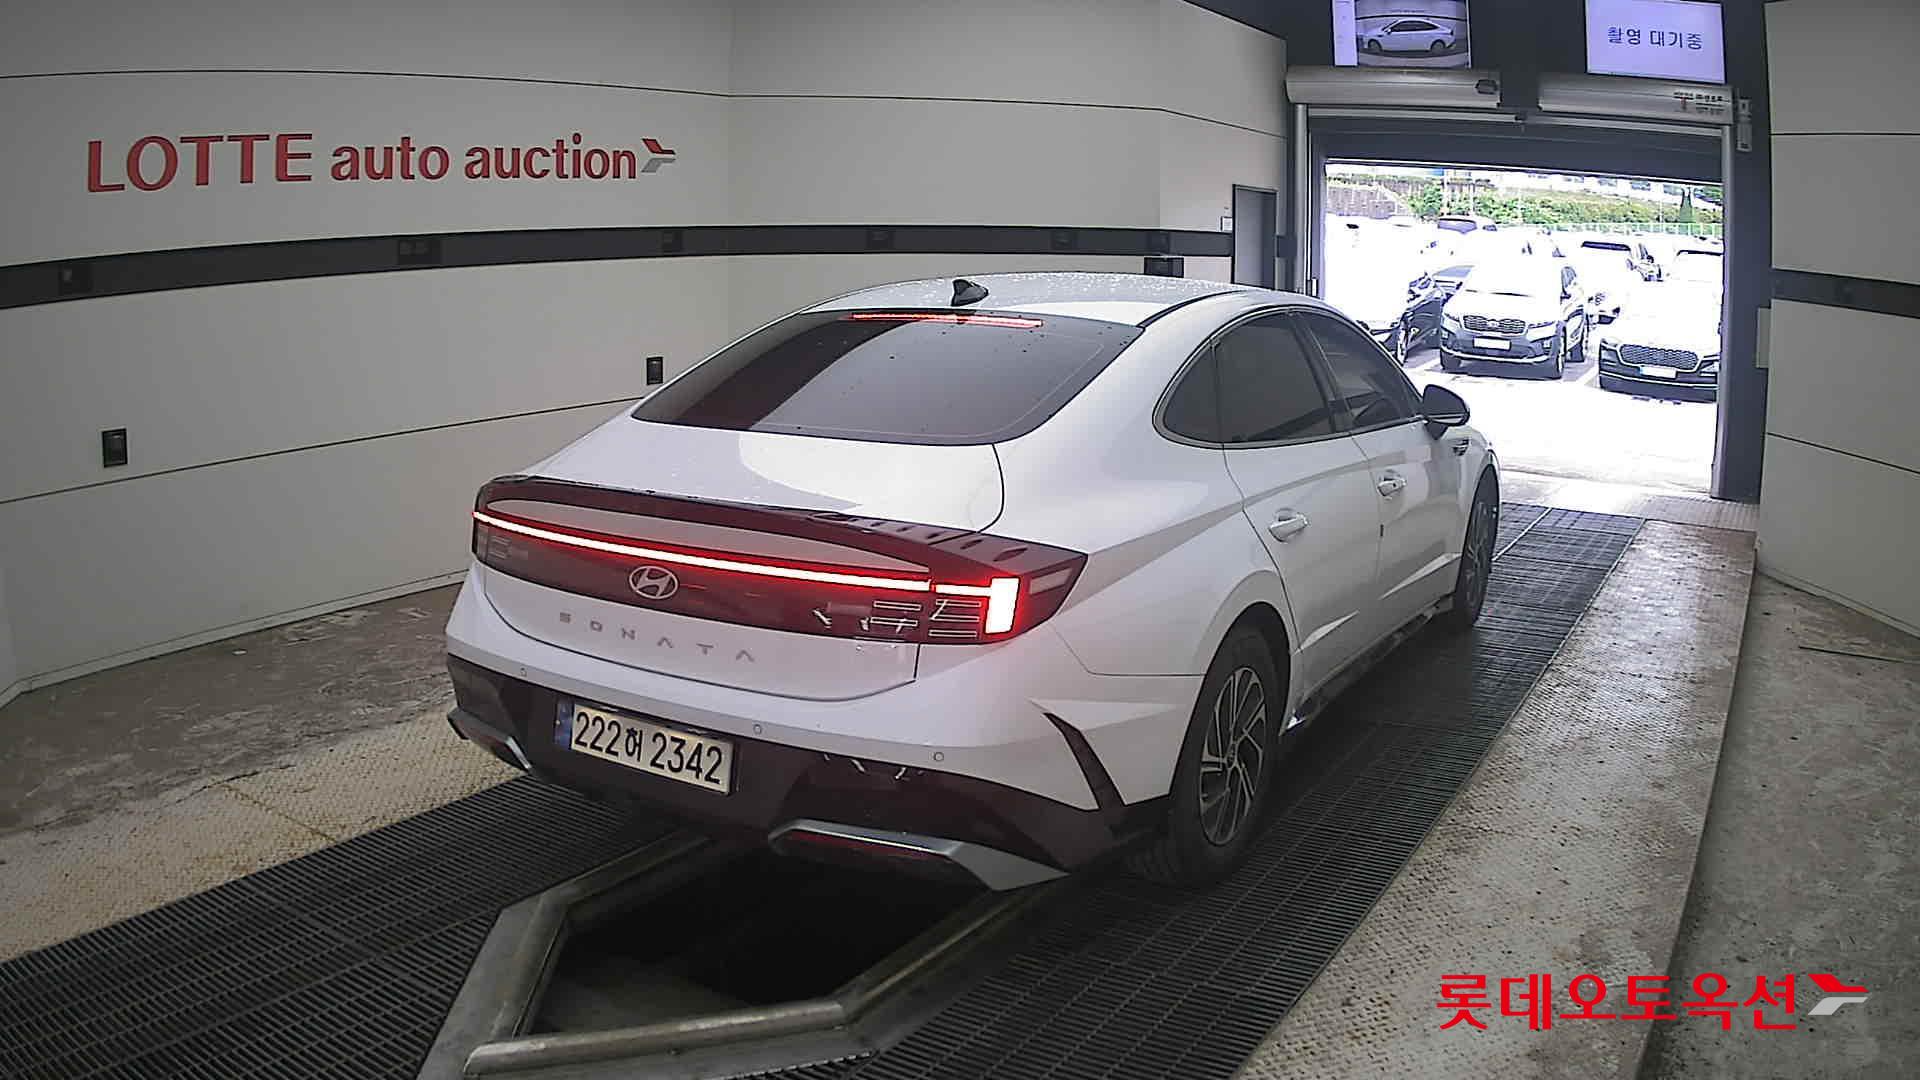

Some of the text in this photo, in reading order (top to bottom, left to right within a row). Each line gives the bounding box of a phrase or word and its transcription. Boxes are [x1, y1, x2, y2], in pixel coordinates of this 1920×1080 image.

[1649, 30, 1702, 50] 대기중
[87, 132, 637, 193] LOTTE auto auction
[559, 611, 755, 663] SONATA
[574, 711, 723, 785] 222허 2342
